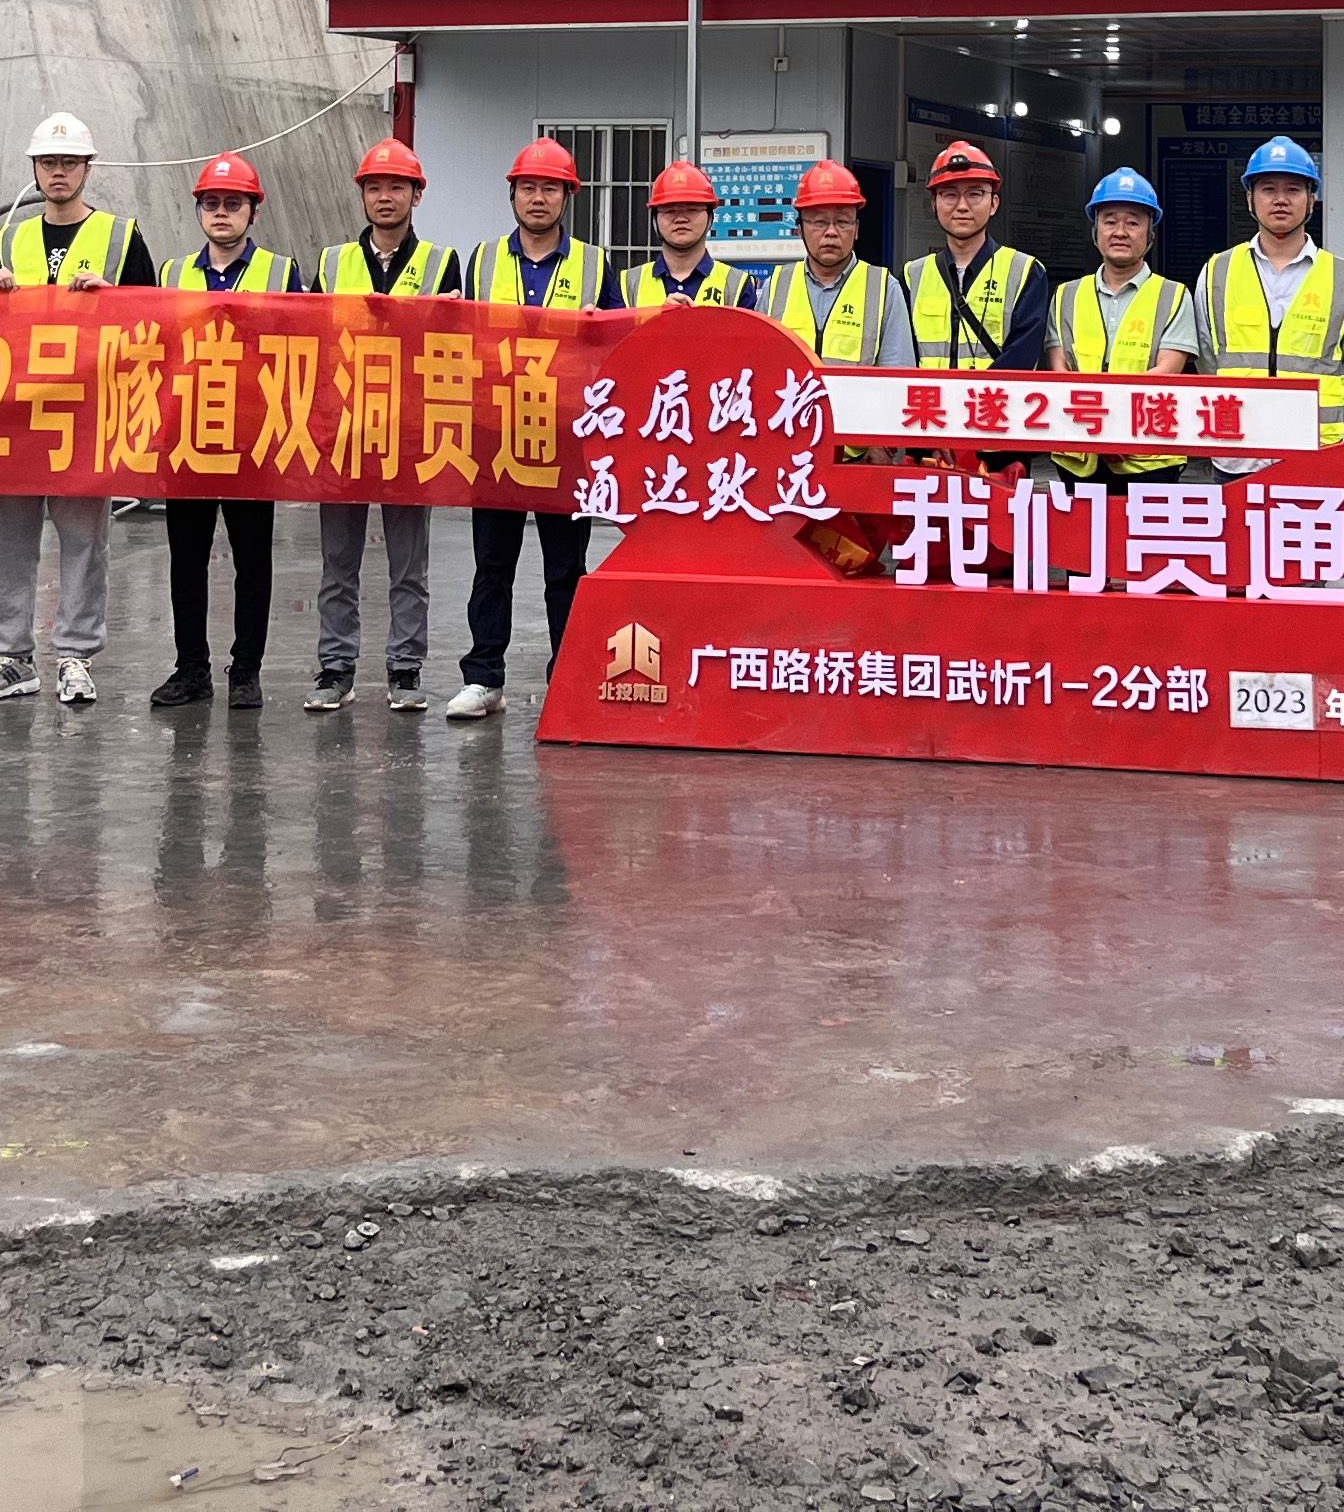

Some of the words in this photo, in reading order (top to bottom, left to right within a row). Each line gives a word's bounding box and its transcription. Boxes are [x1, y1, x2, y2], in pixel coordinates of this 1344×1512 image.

[1197, 105, 1321, 126] 提高全员安全意识
[720, 184, 784, 195] 安全生产记录
[785, 211, 795, 222] 天
[571, 367, 829, 447] 品质路桥
[901, 384, 1246, 441] 果遂2号隧道
[571, 451, 842, 524] 通达致远
[597, 681, 668, 704] 北投集团
[687, 644, 1209, 715] 广西路桥集团武忻1-2分部
